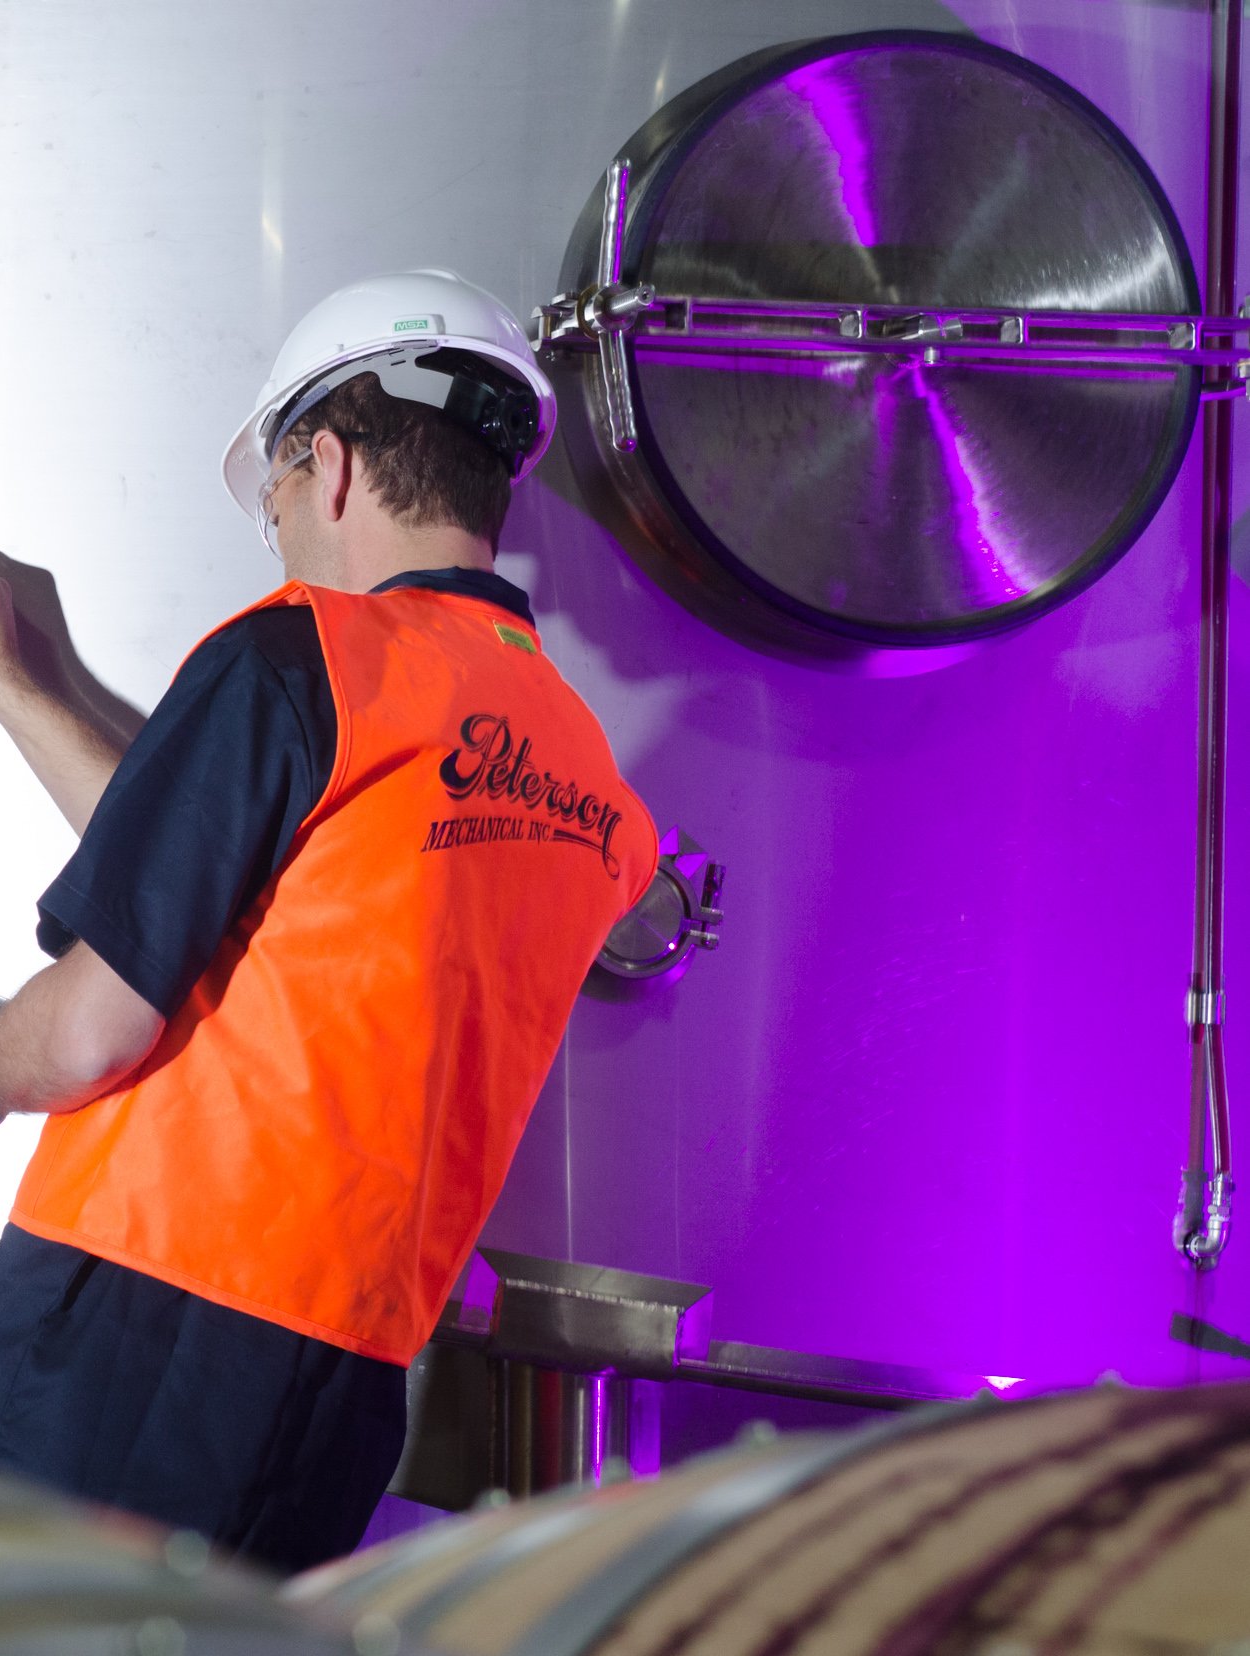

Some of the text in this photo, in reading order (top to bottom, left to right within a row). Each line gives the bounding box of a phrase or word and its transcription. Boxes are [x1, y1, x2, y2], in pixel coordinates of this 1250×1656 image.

[395, 321, 427, 331] MSA
[438, 711, 622, 880] Peterson
[421, 816, 524, 852] MECHANICAL
